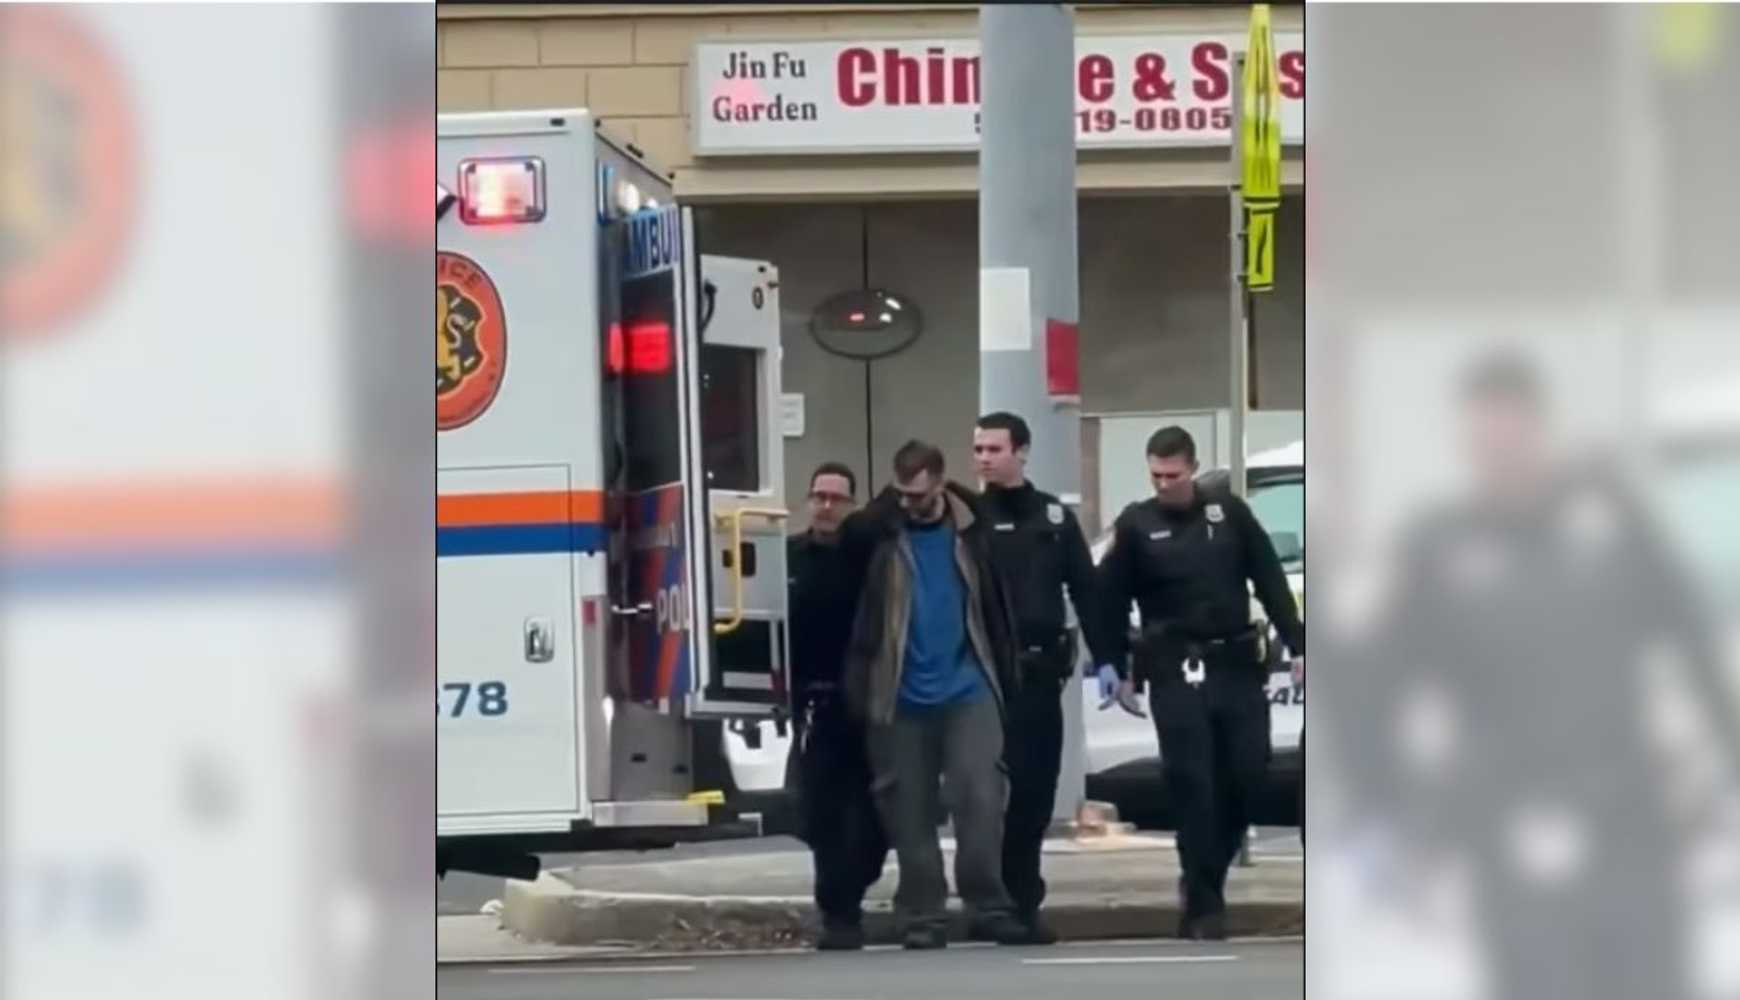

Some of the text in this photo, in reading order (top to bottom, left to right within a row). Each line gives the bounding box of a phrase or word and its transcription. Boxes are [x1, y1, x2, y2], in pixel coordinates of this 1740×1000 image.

[722, 51, 806, 79] Jin Fu
[1132, 53, 1177, 103] &
[712, 93, 818, 122] Garden
[437, 681, 508, 718] 78
